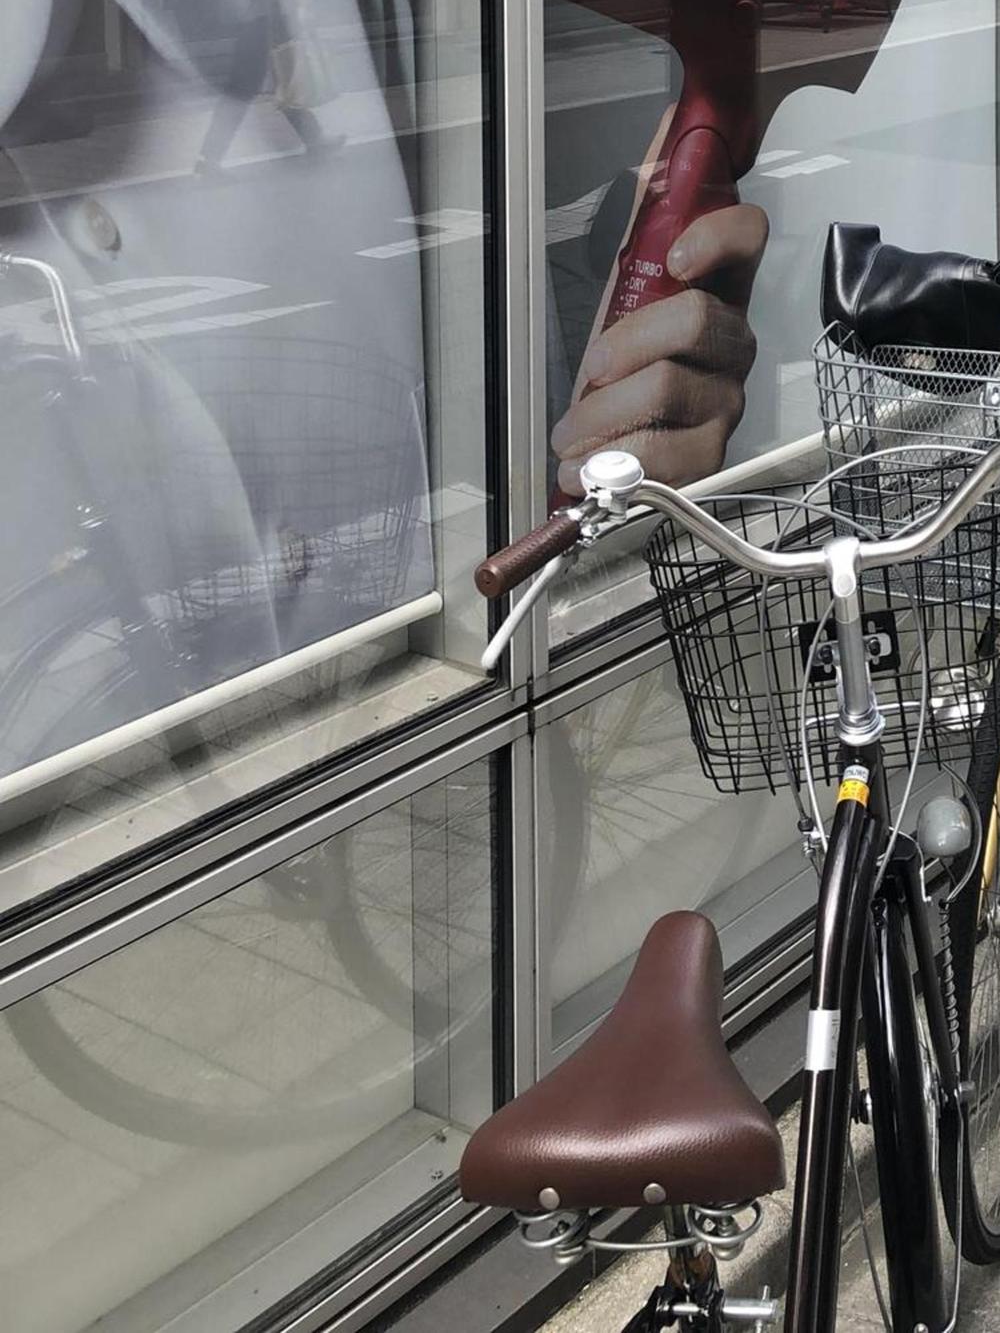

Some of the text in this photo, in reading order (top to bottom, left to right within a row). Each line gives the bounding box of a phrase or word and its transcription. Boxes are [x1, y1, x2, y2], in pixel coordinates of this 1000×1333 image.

[634, 259, 663, 277] TURBO
[628, 276, 647, 292] DRY
[624, 293, 639, 308] SET
